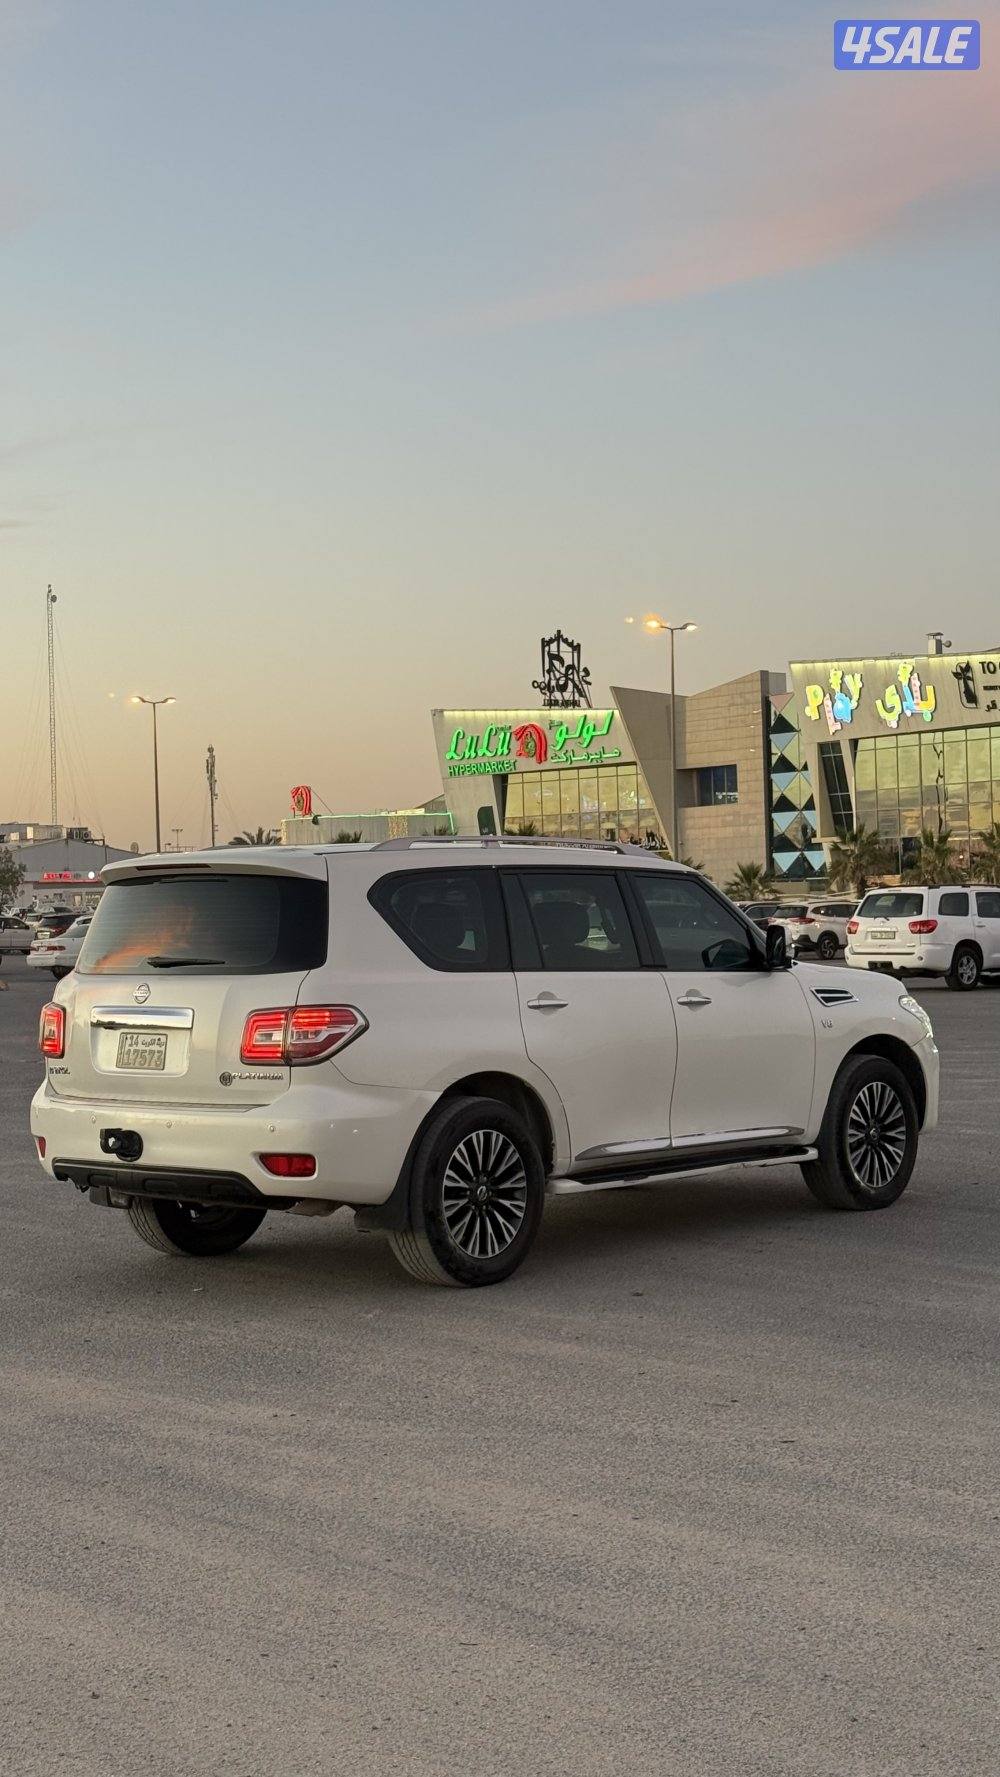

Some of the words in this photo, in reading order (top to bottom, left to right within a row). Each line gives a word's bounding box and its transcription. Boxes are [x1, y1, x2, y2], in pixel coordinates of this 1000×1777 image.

[979, 661, 997, 675] TO
[551, 710, 615, 752] لولو
[447, 759, 518, 777] HYPERMARKET
[122, 1048, 163, 1067] 17573
